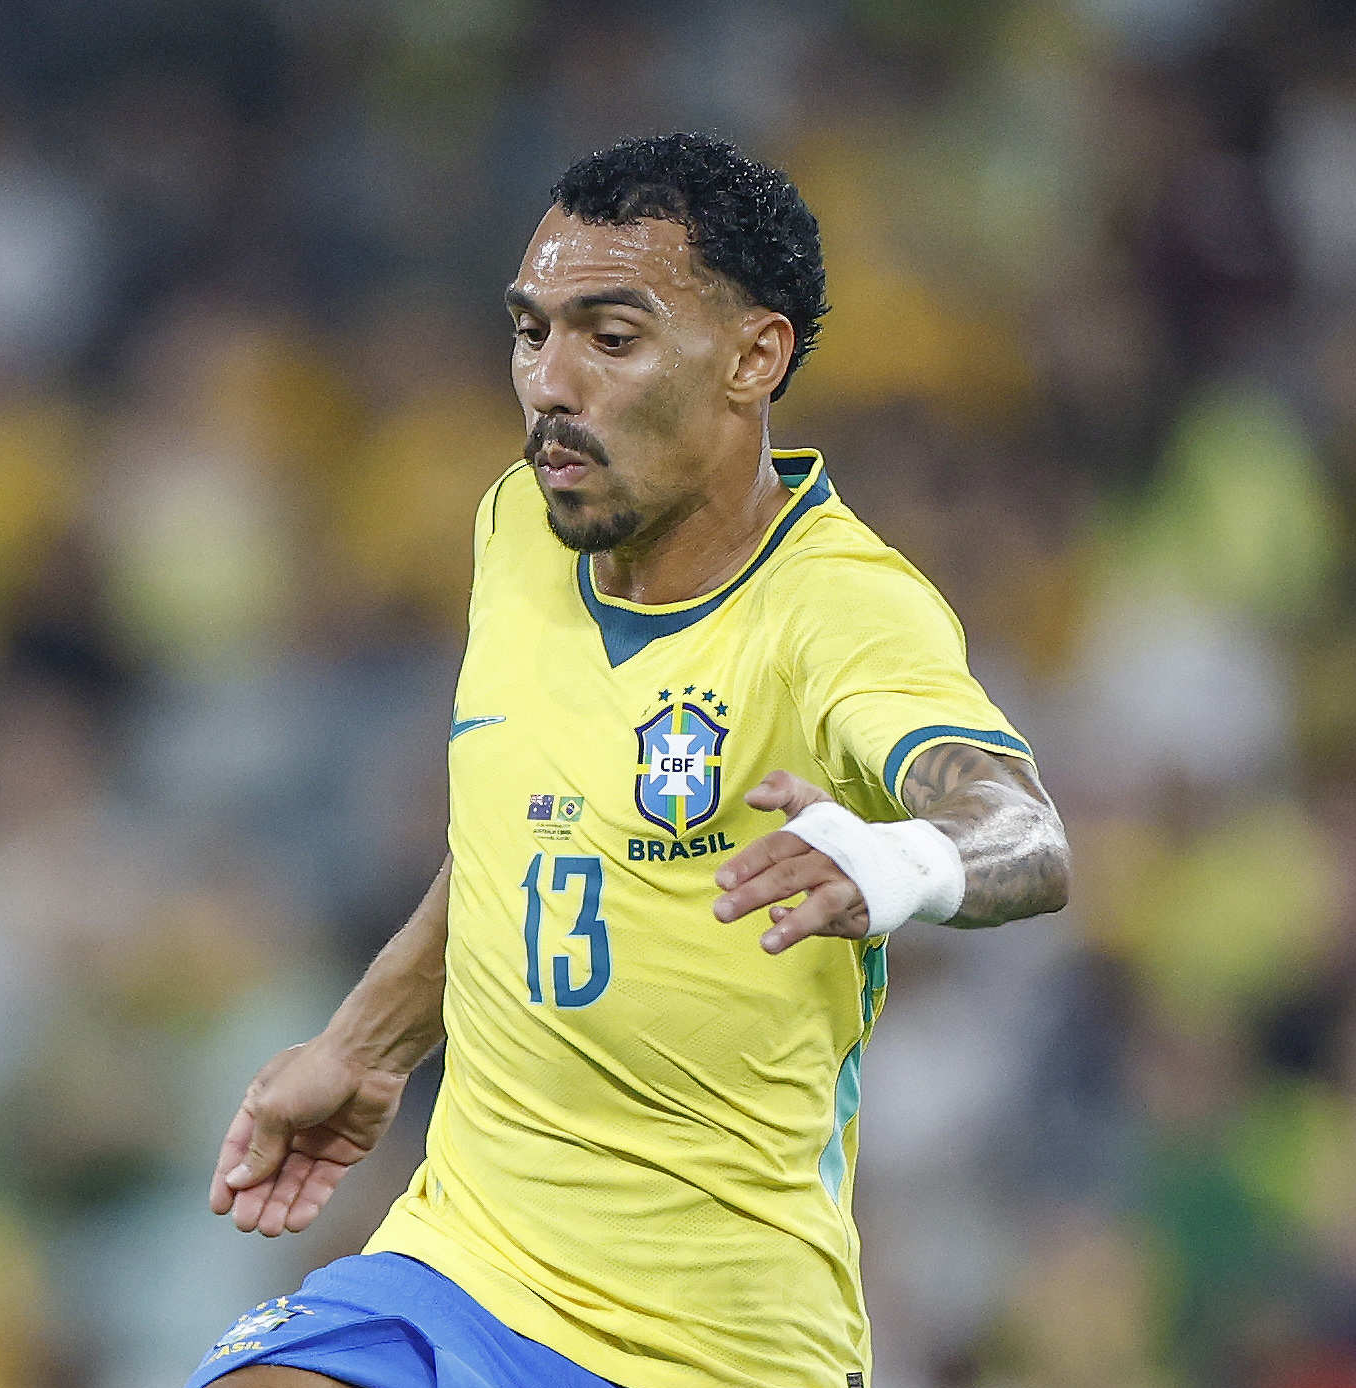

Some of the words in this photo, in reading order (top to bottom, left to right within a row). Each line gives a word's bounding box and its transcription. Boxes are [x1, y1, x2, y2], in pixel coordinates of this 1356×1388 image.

[660, 757, 695, 773] CBF
[627, 831, 736, 862] BRASIL
[520, 851, 612, 1010] 13
